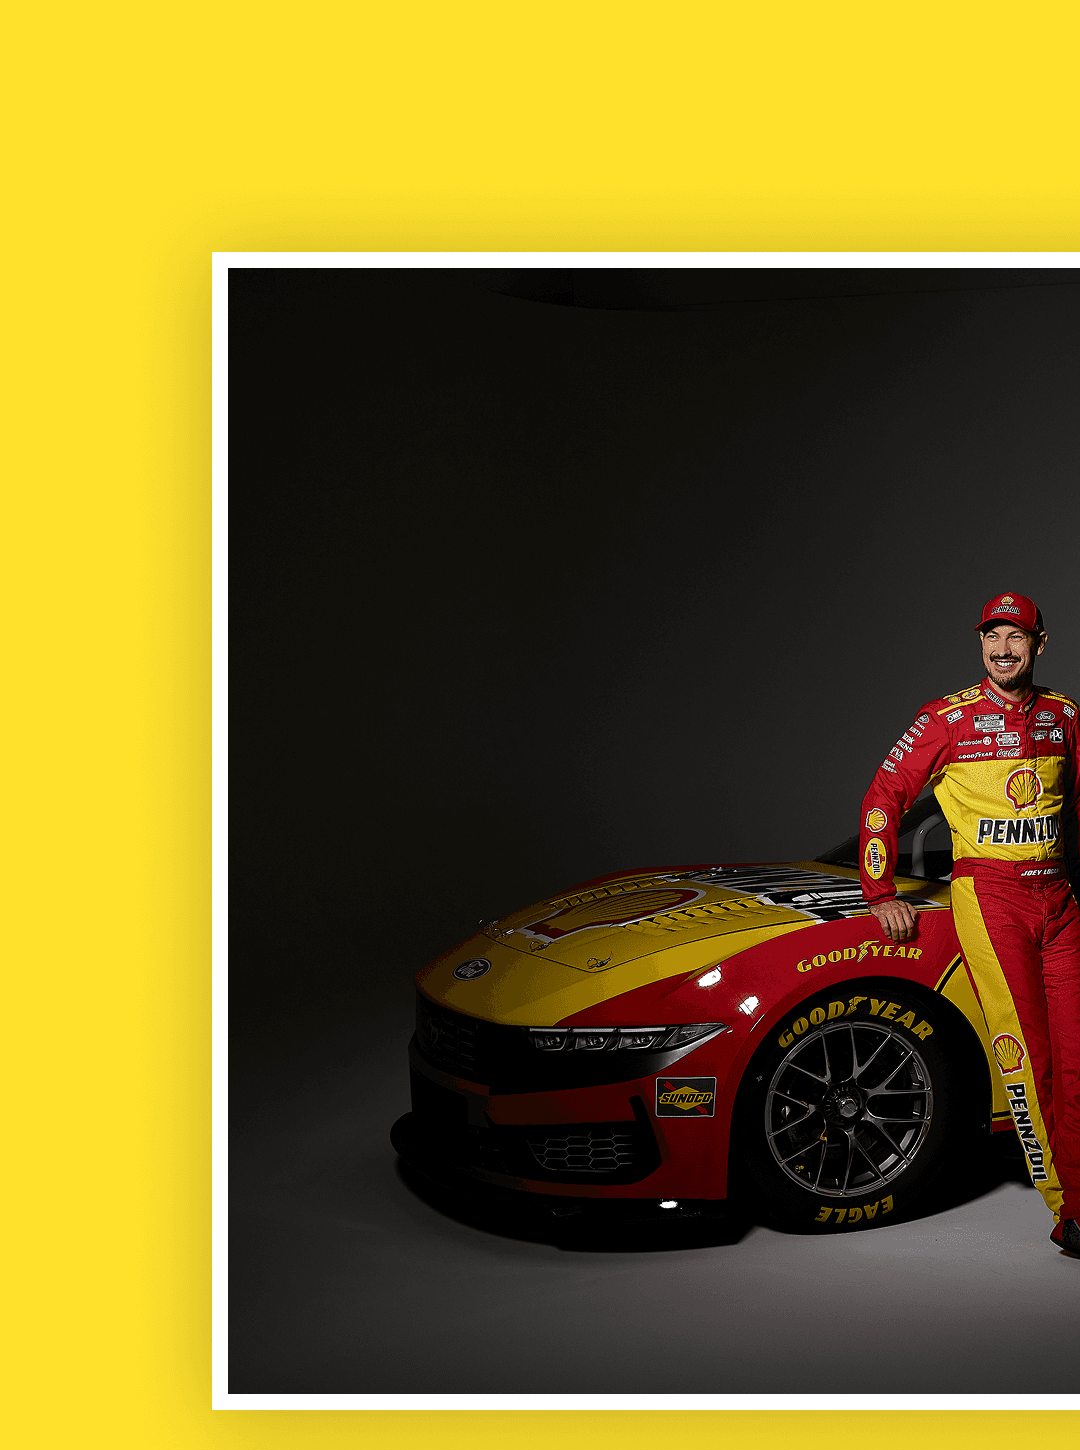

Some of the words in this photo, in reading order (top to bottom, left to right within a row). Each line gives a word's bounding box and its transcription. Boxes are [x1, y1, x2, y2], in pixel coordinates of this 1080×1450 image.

[946, 709, 964, 724] OMP
[958, 751, 994, 760] GOODYEAR
[869, 842, 882, 875] PENNZOIL
[1020, 869, 1042, 877] JOEY
[796, 940, 924, 974] GOODYEAR
[777, 995, 935, 1050] GOODYEAR
[658, 1092, 714, 1105] SUNOCO
[1005, 1083, 1050, 1185] PENNZOIL
[815, 1194, 895, 1224] EAGLE
